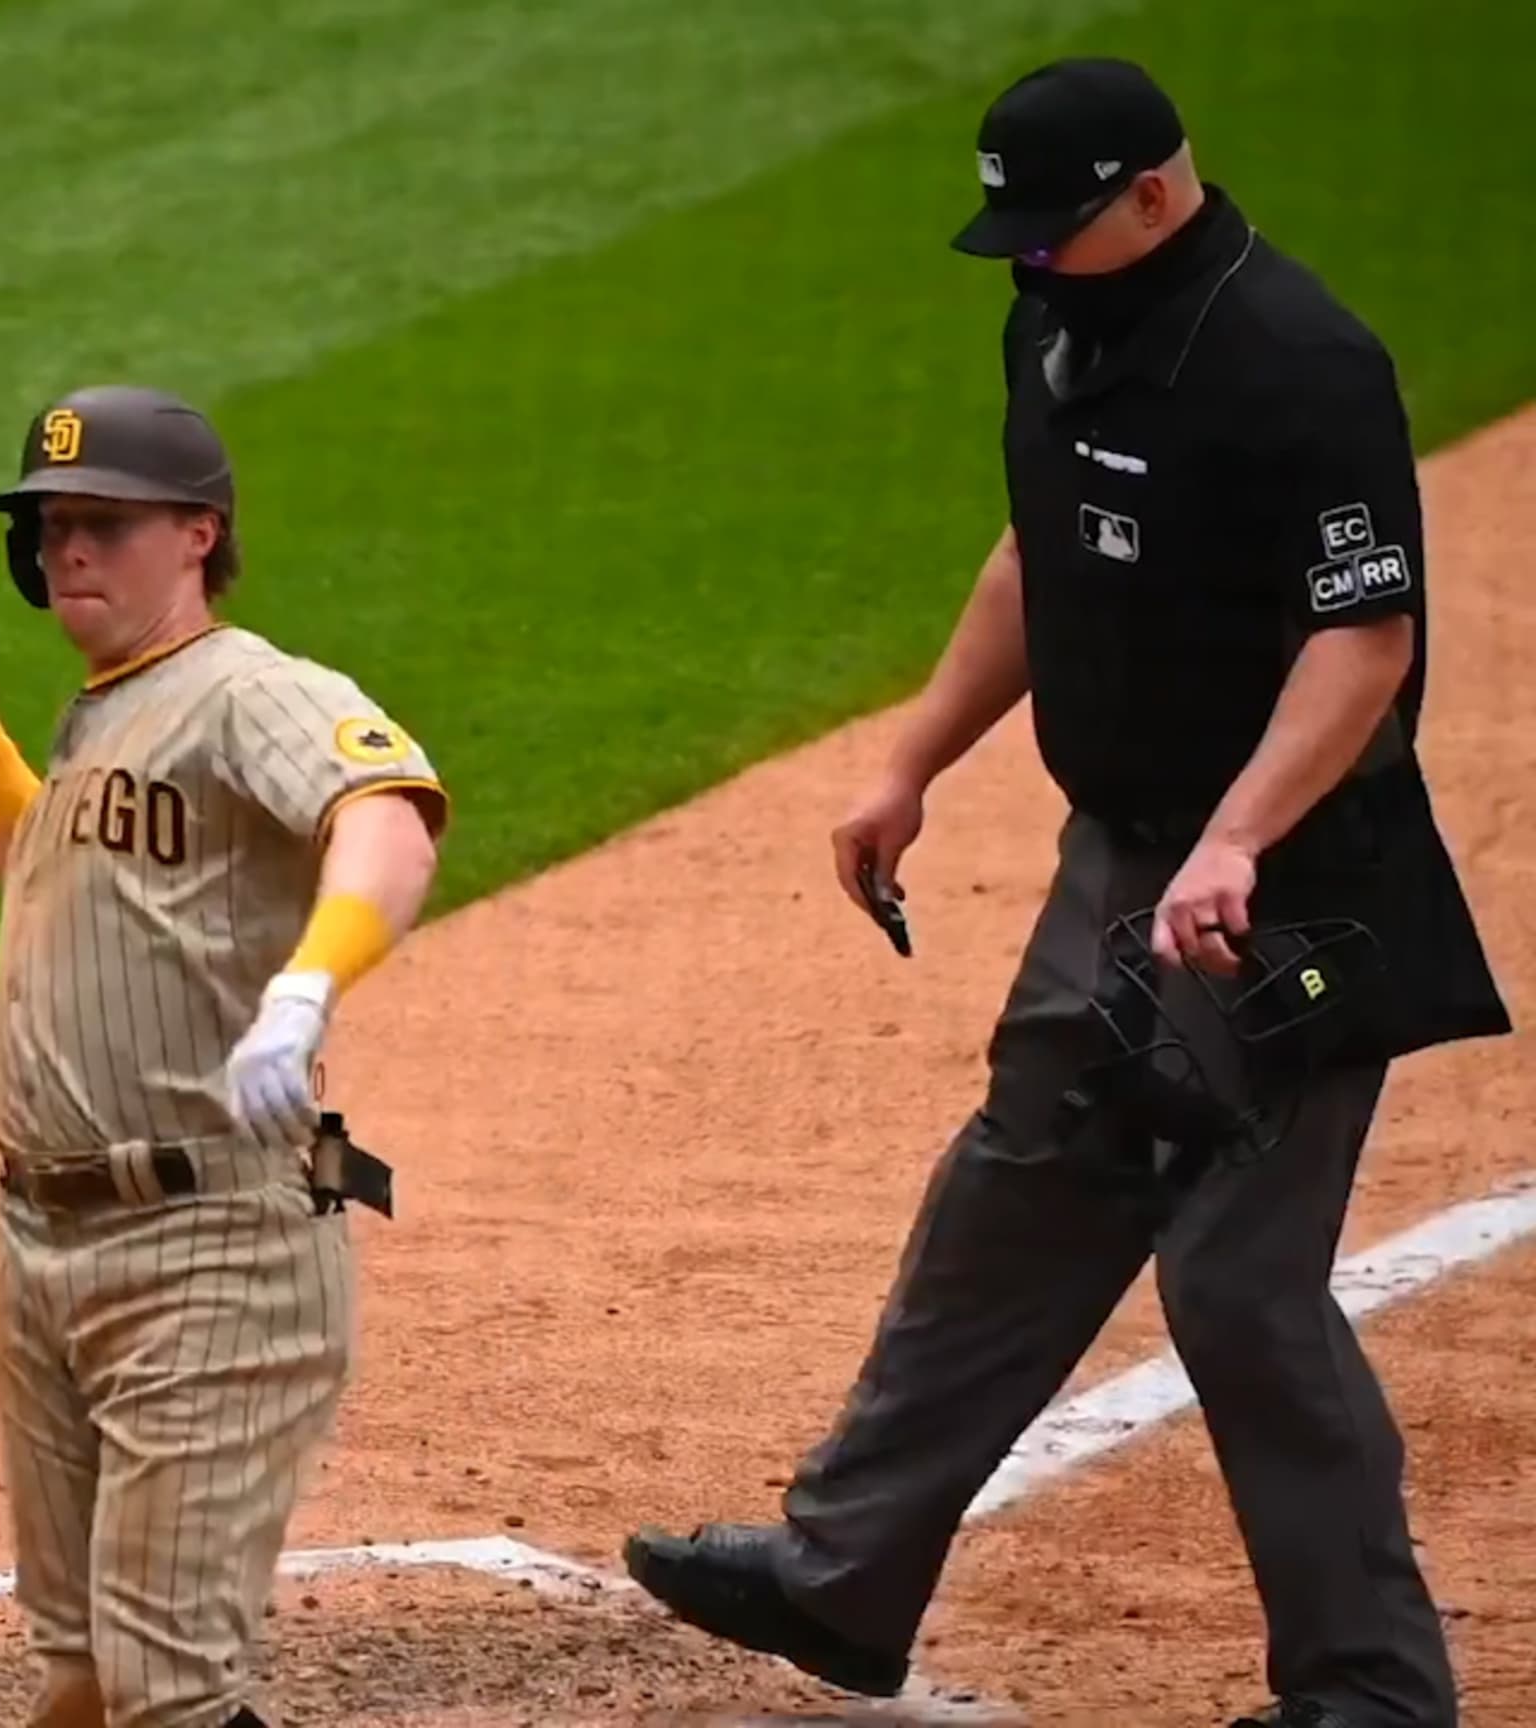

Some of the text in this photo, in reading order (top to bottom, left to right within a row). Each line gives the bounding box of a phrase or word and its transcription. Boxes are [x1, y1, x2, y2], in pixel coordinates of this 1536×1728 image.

[1326, 518, 1367, 547] EC
[1314, 557, 1402, 600] CM RR
